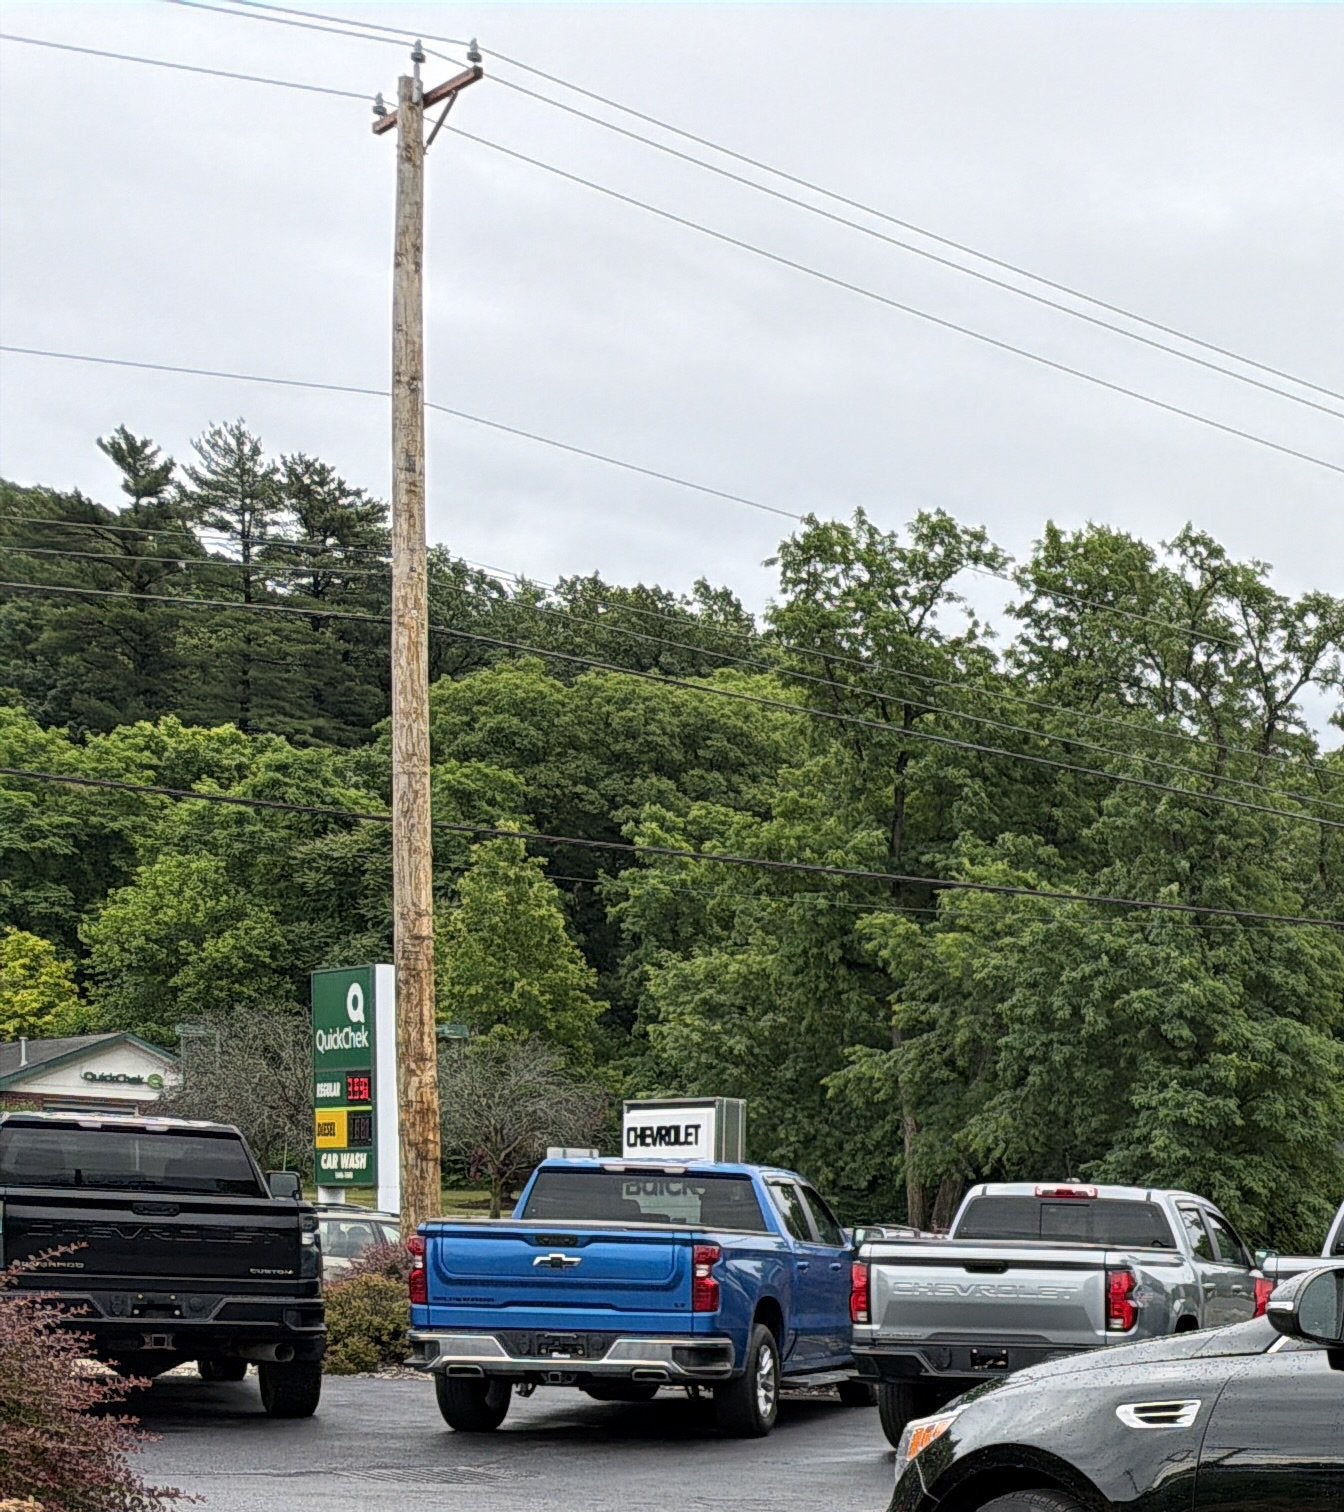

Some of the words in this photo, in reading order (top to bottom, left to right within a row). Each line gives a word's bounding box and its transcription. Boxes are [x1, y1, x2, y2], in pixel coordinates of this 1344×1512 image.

[316, 1025, 369, 1054] QuickChek
[316, 1082, 341, 1098] REGULAR
[317, 1122, 336, 1137] DIESEL
[626, 1123, 702, 1148] CHEVROLET
[321, 1153, 338, 1170] CAR
[341, 1152, 368, 1170] WASH
[893, 1281, 1079, 1300] CHEVROLET
